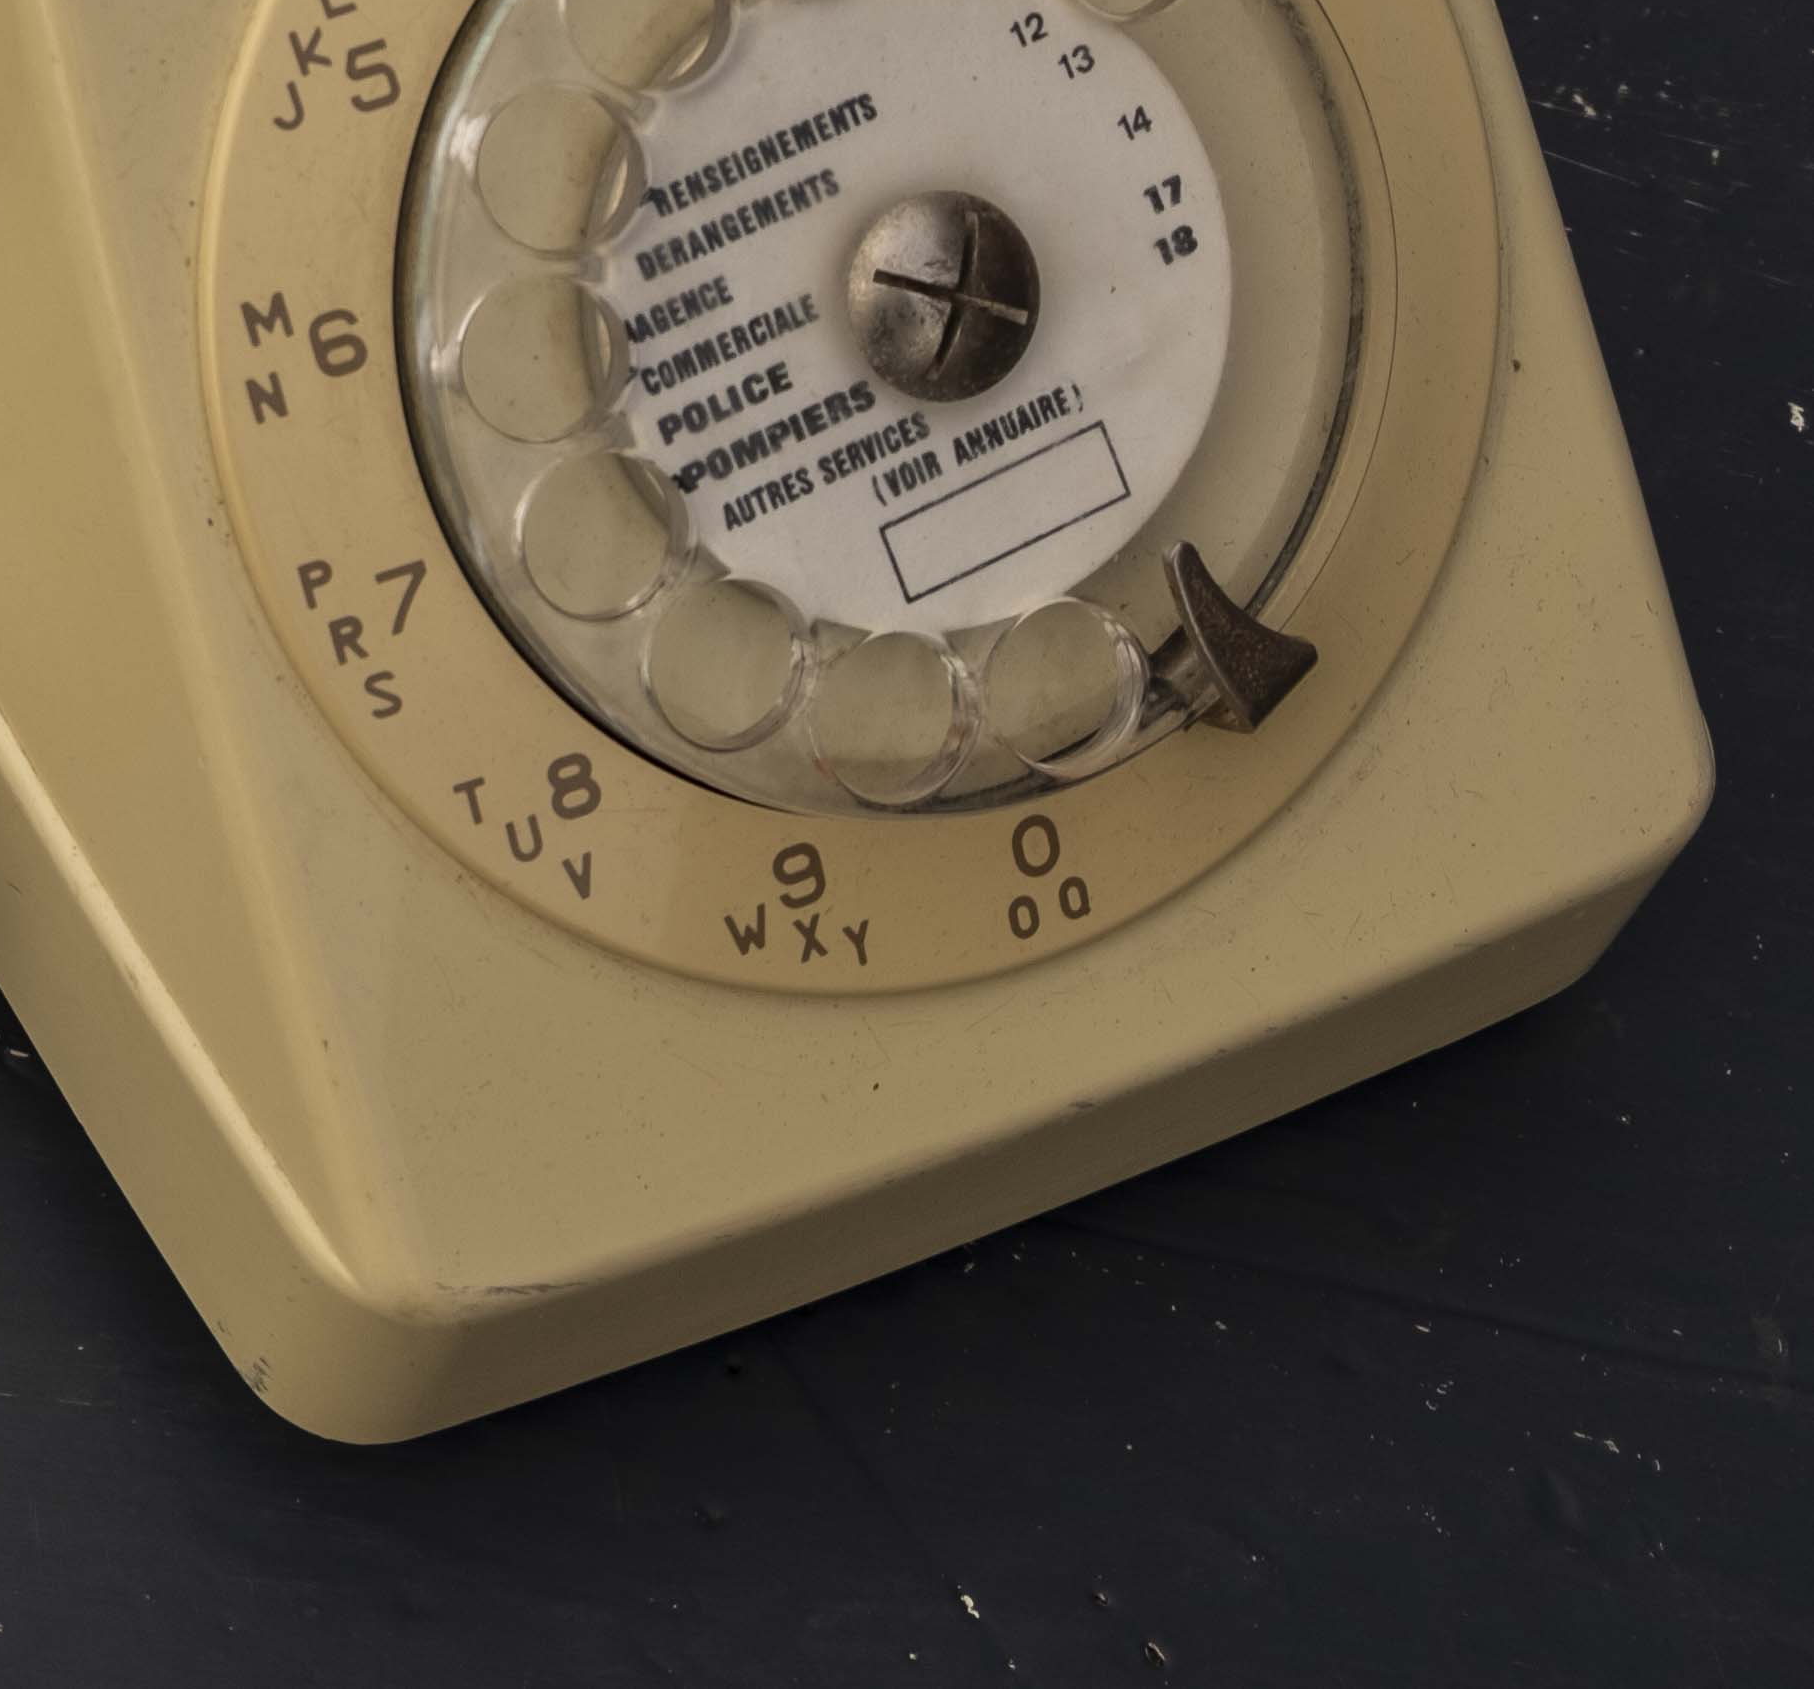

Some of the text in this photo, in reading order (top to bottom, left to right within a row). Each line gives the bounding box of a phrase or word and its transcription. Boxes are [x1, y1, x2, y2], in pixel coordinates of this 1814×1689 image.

[1009, 12, 1049, 47] 12
[1057, 44, 1095, 80] 13
[346, 38, 401, 113] 5
[648, 93, 878, 217] RENSEIGNEMENTS
[1117, 105, 1152, 141] 14
[636, 168, 840, 281] DERANGEMENTS
[1143, 174, 1181, 214] 17
[1153, 225, 1198, 265] 18
[308, 308, 368, 378] 6
[640, 293, 820, 396] COMMERCIALE
[656, 360, 794, 445] POLICE
[676, 380, 877, 494] POMPIERS
[722, 411, 931, 531] AUTRES SERVICES
[872, 383, 1084, 506] (VOIR ANNUAIRE)
[374, 558, 428, 637] 7
[546, 751, 603, 821] 8
[772, 841, 827, 910] 9
[1011, 813, 1061, 878] 0
[723, 901, 870, 967] WXY
